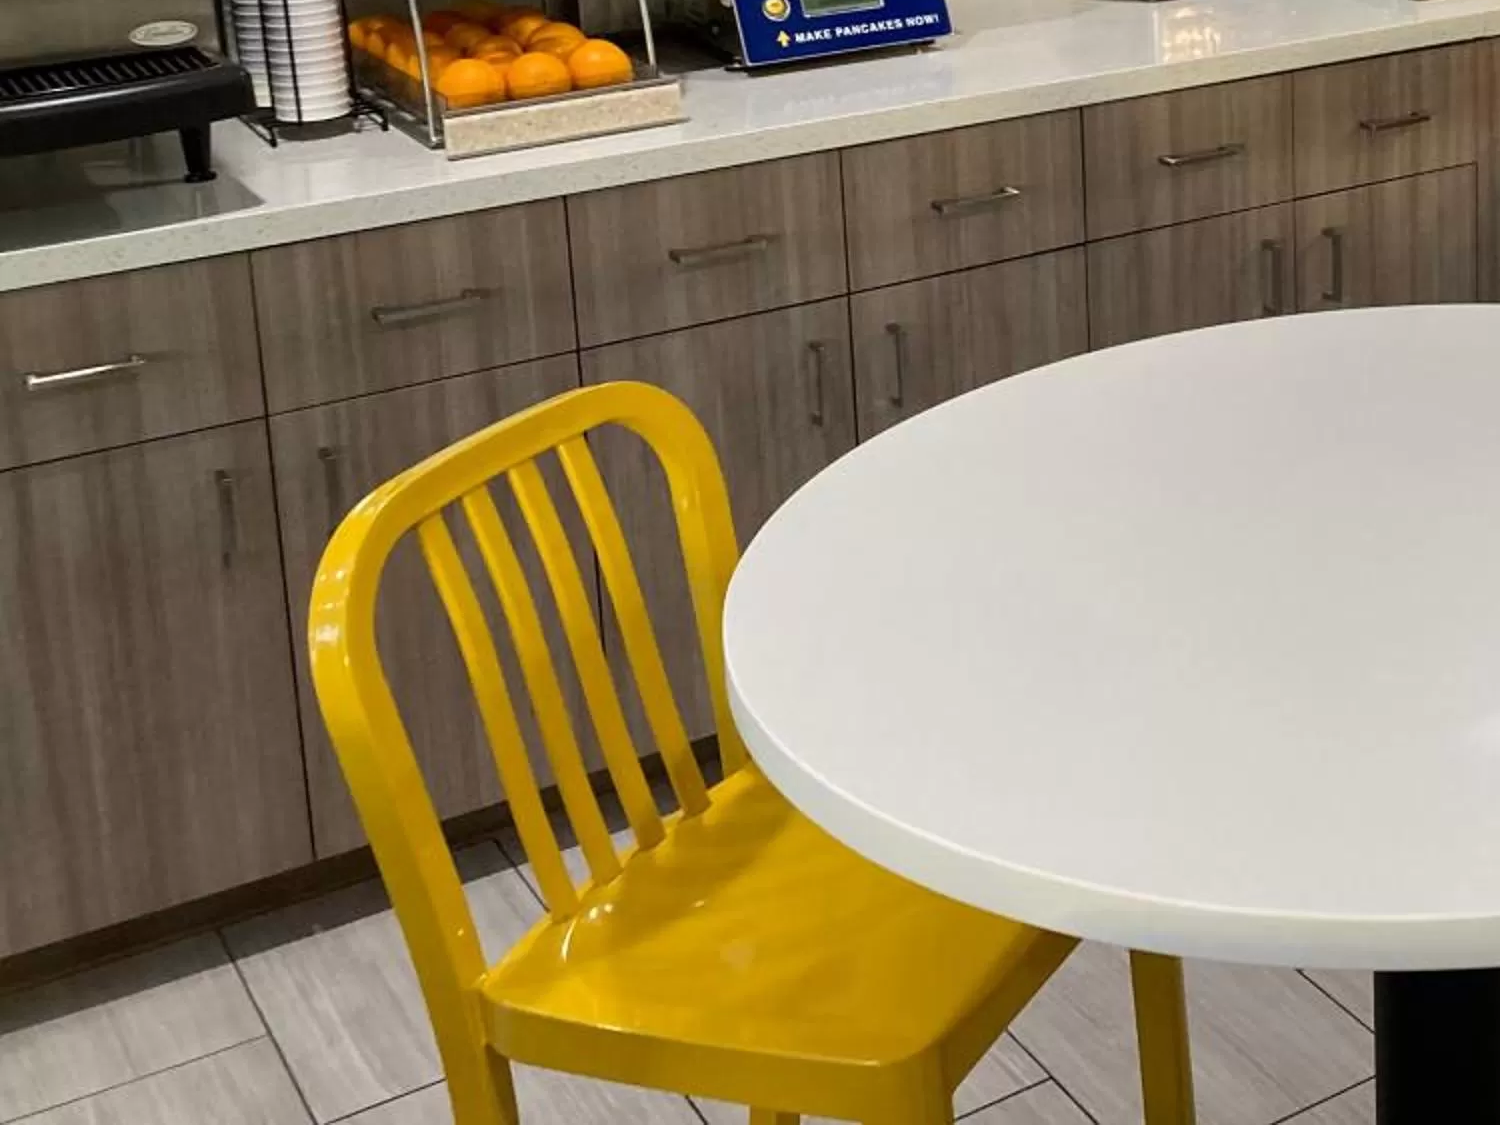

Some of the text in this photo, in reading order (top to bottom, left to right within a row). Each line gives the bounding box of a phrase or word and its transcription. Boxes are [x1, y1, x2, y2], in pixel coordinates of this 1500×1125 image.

[795, 14, 940, 42] MAKE PANCAKES NOW!
